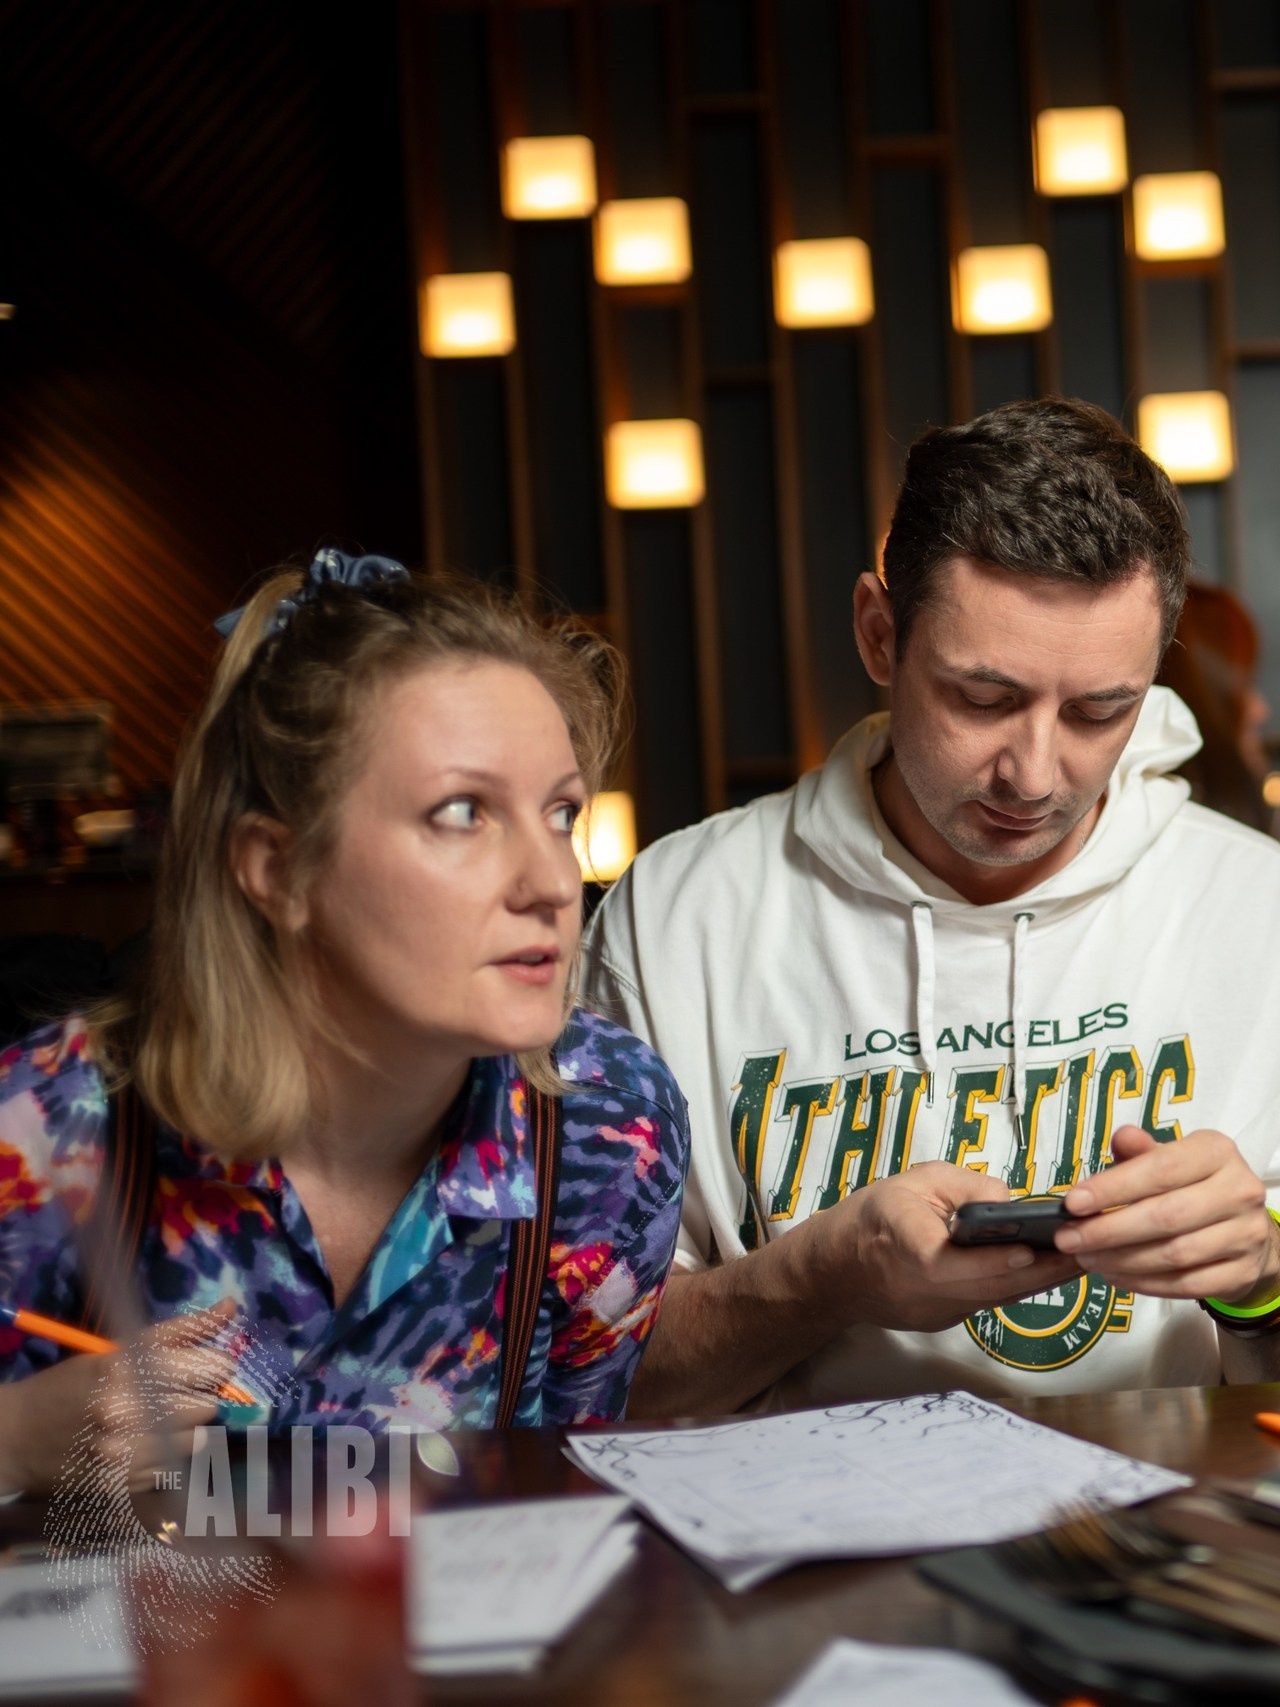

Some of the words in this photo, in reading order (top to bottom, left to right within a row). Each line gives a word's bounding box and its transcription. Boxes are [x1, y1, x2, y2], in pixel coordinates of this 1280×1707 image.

[844, 1029, 921, 1062] LOS
[935, 1002, 1129, 1054] ANGELES
[1061, 1284, 1108, 1351] TEAM
